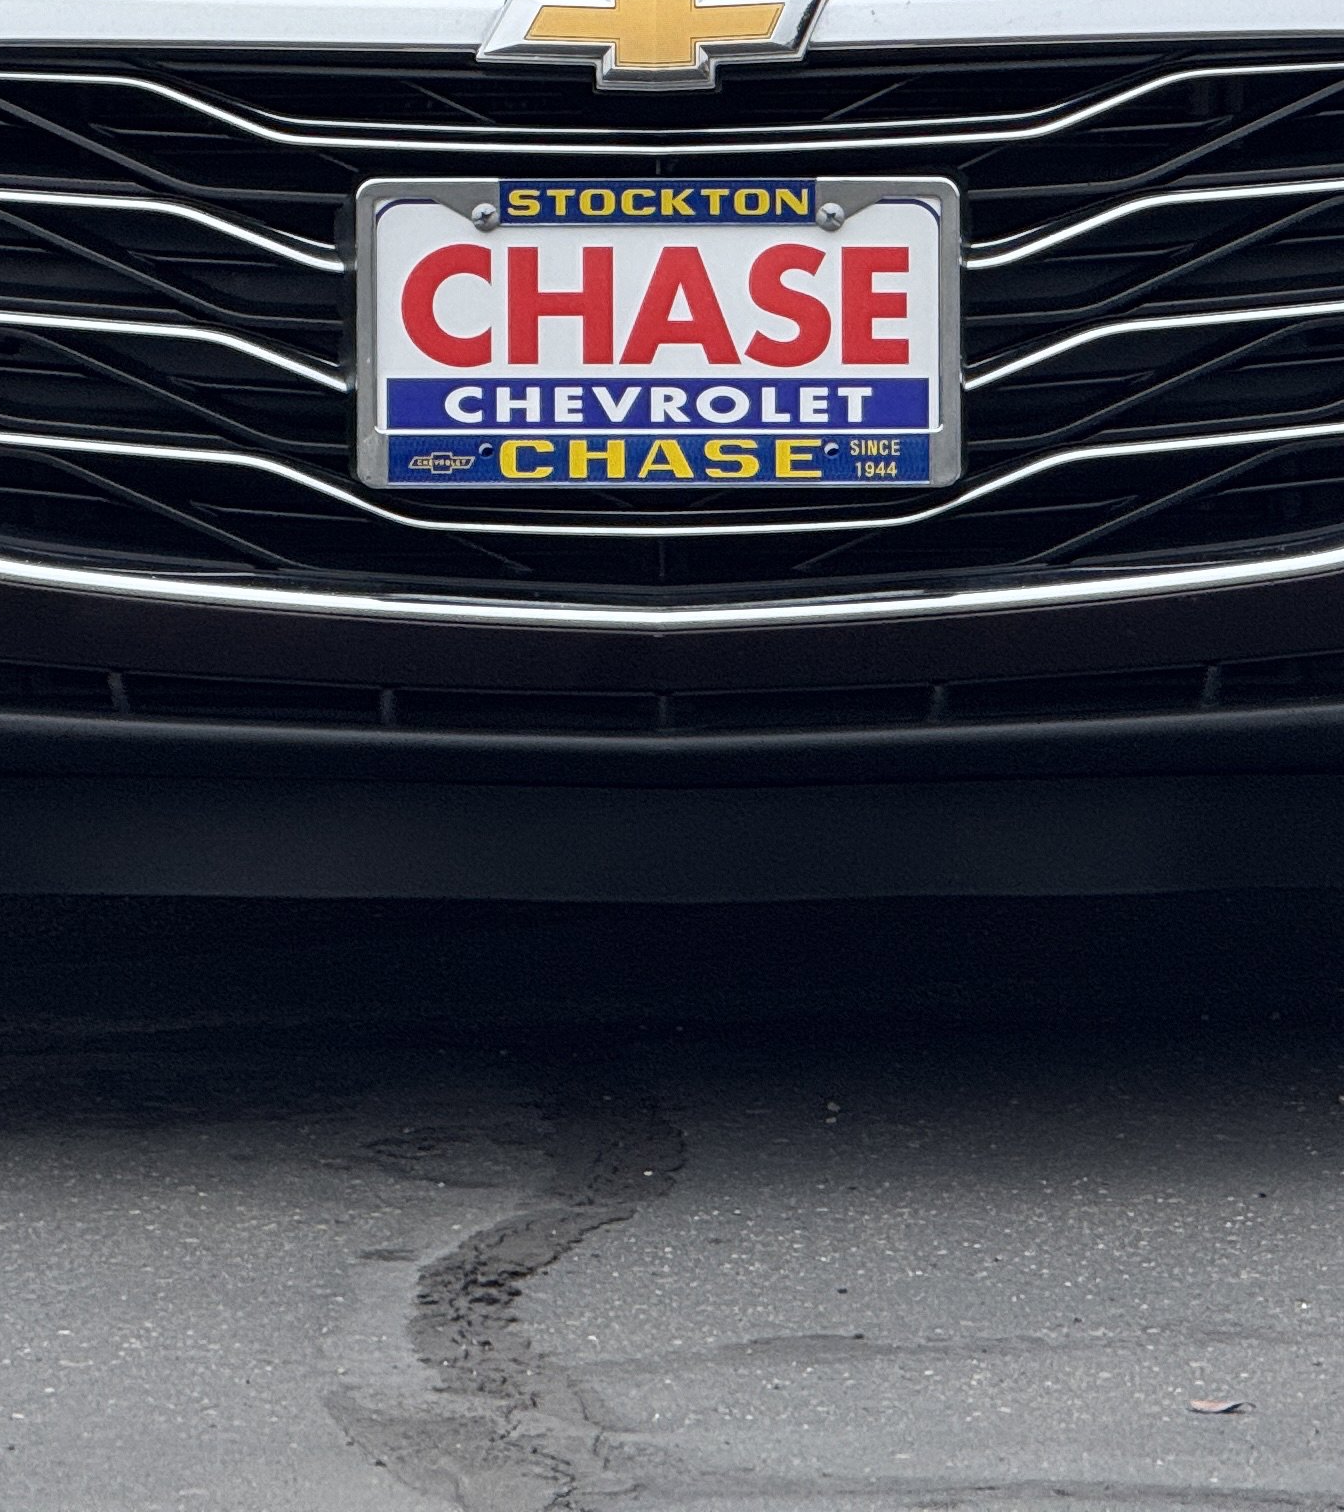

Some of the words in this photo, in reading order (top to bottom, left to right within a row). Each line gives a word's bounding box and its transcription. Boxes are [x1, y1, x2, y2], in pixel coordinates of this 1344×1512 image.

[507, 188, 810, 216] STOCKTON
[401, 243, 910, 368] CHASE
[444, 385, 873, 424] CHEVROLET
[499, 438, 823, 479] CHASE
[850, 438, 901, 456] SINCE
[416, 458, 467, 467] CHEVROLET
[855, 461, 898, 478] 1944
